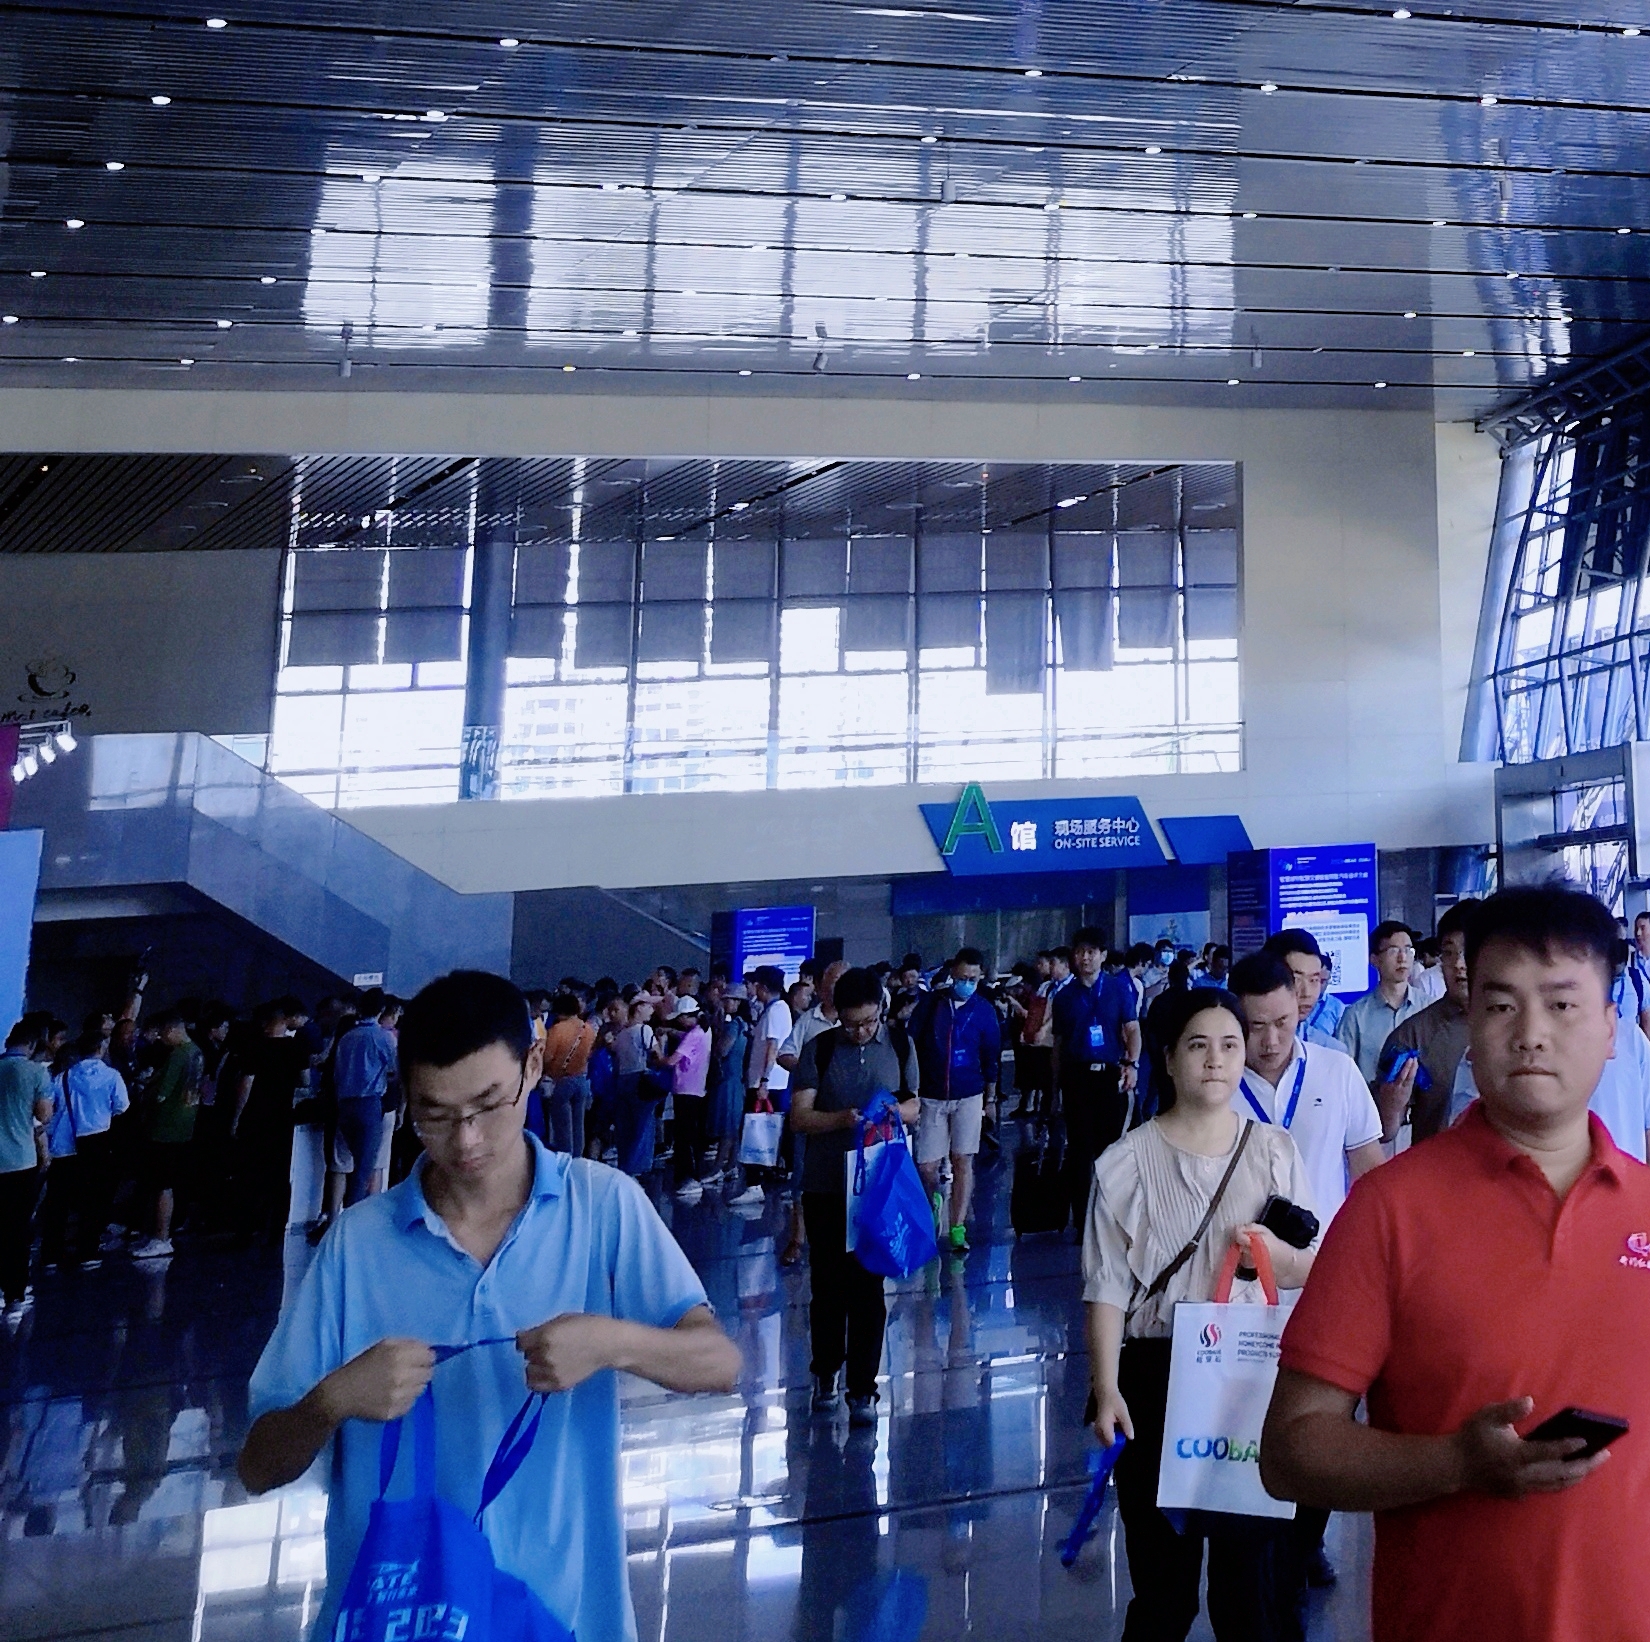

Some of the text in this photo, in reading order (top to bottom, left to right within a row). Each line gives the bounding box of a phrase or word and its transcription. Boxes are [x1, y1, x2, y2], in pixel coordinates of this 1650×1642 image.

[942, 780, 1037, 855] A 馆
[1054, 817, 1140, 836] 现场服务中心
[1054, 835, 1141, 850] ON-SITE SERVICE
